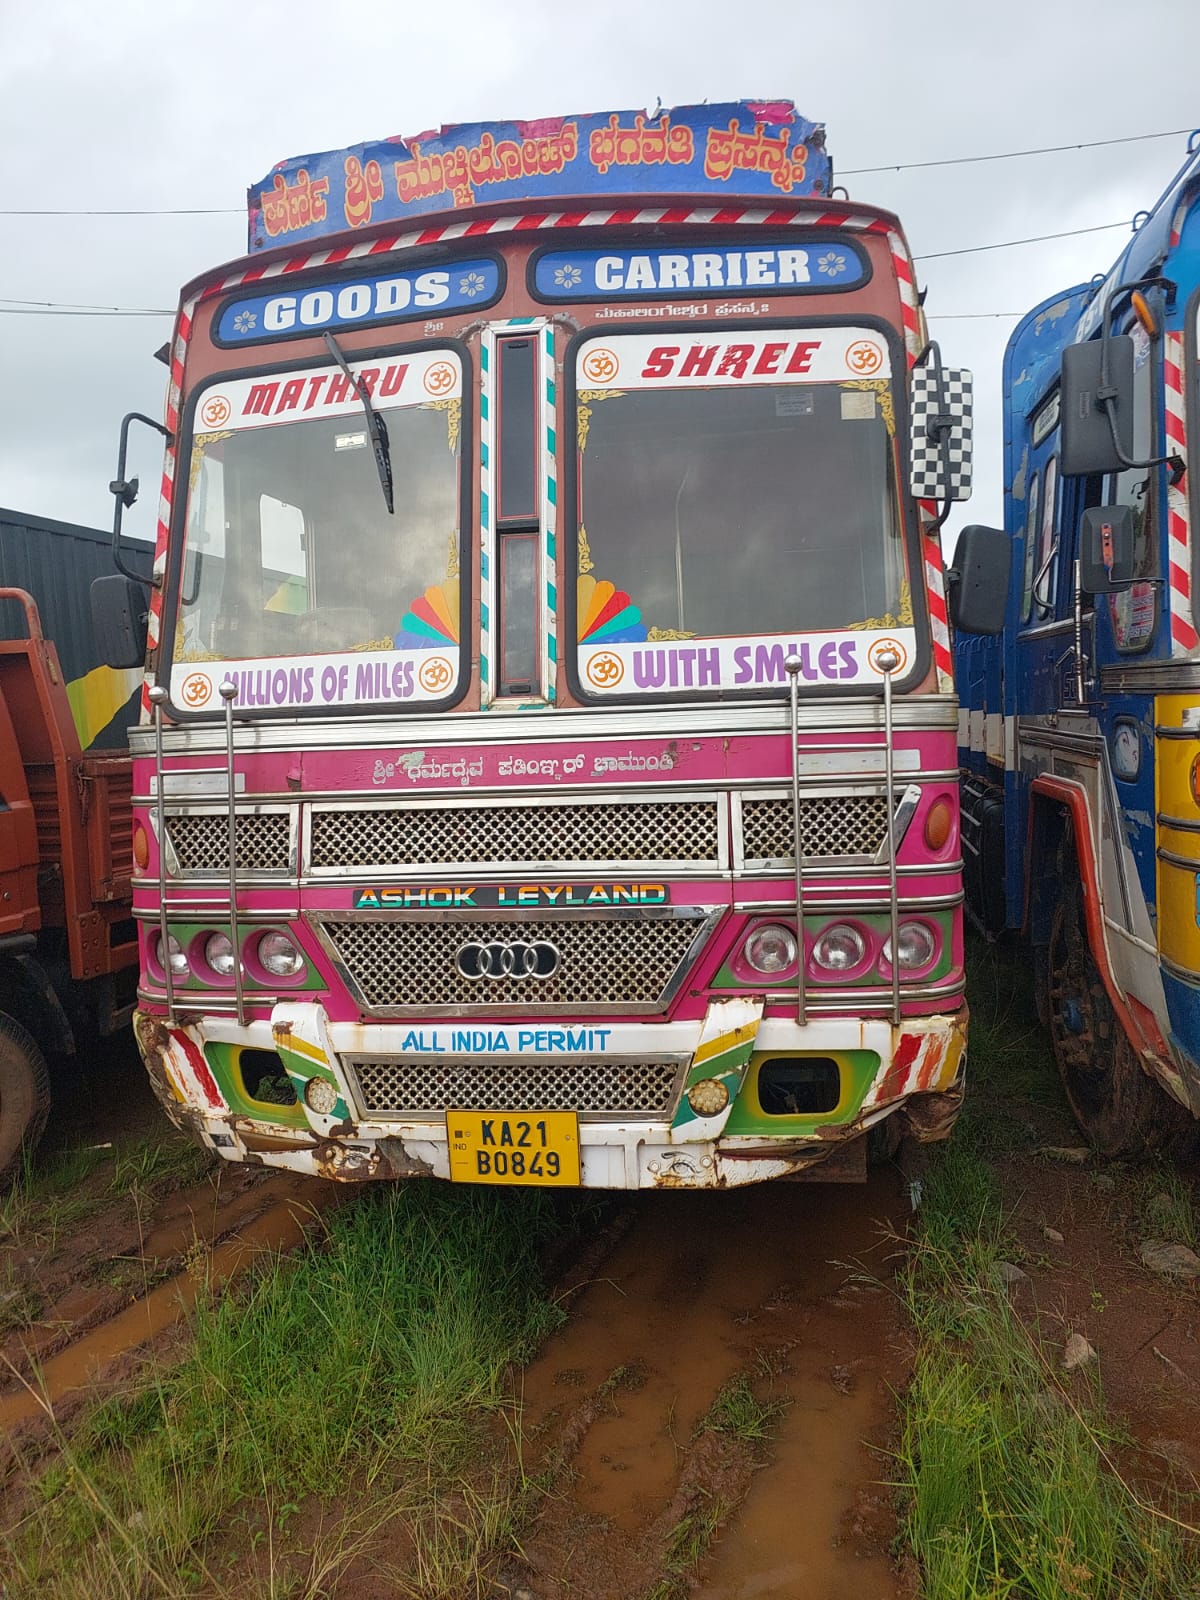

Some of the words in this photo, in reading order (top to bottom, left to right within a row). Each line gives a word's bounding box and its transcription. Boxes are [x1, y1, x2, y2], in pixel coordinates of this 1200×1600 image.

[344, 155, 384, 228] ಶ್ರೀ
[589, 113, 694, 174] ಭಗವತಿ
[595, 250, 811, 291] CARRIER
[263, 272, 450, 332] GOODS
[641, 341, 822, 379] SHREE
[241, 364, 410, 416] MATHRU
[321, 664, 349, 704] OF
[355, 661, 415, 701] MILES
[633, 647, 721, 688] WITH
[372, 759, 395, 784] ಶ್ರೀ
[356, 887, 477, 908] ASHOK
[498, 884, 665, 906] LEYLAND
[401, 1030, 445, 1052] ALL
[452, 1030, 510, 1052] INDIA
[518, 1029, 611, 1052] PERMIT
[453, 1143, 467, 1151] IND
[481, 1119, 547, 1147] KA21
[477, 1150, 560, 1177] B0849
